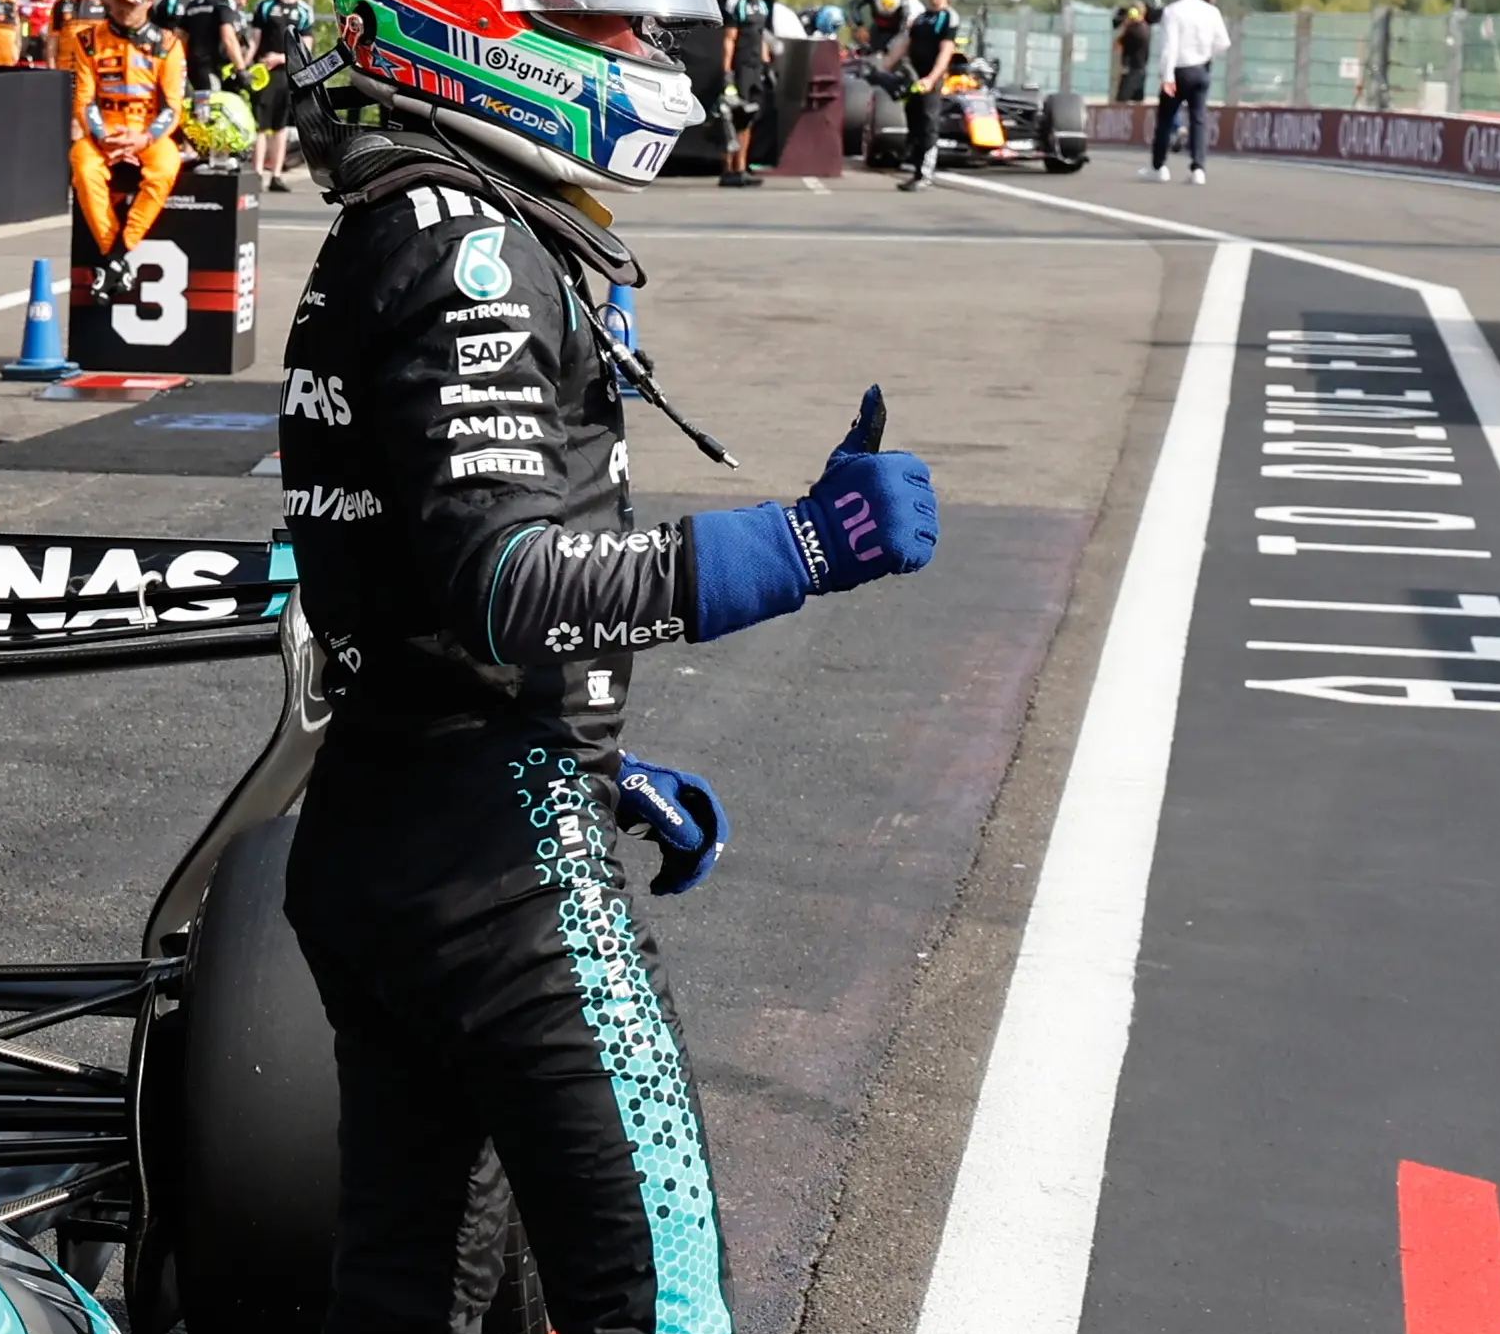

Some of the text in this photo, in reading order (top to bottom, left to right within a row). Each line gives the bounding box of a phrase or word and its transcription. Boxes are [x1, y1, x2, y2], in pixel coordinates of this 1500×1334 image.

[1339, 114, 1444, 164] QATAR AIRWAYS
[111, 239, 189, 346] 3
[446, 302, 531, 324] PETRONAS
[460, 339, 513, 367] SAP
[447, 417, 519, 440] AMD
[451, 447, 545, 478] PIRELLI
[594, 615, 684, 650] Meta
[547, 778, 588, 860] KIMI
[636, 781, 683, 826] WhatsApp
